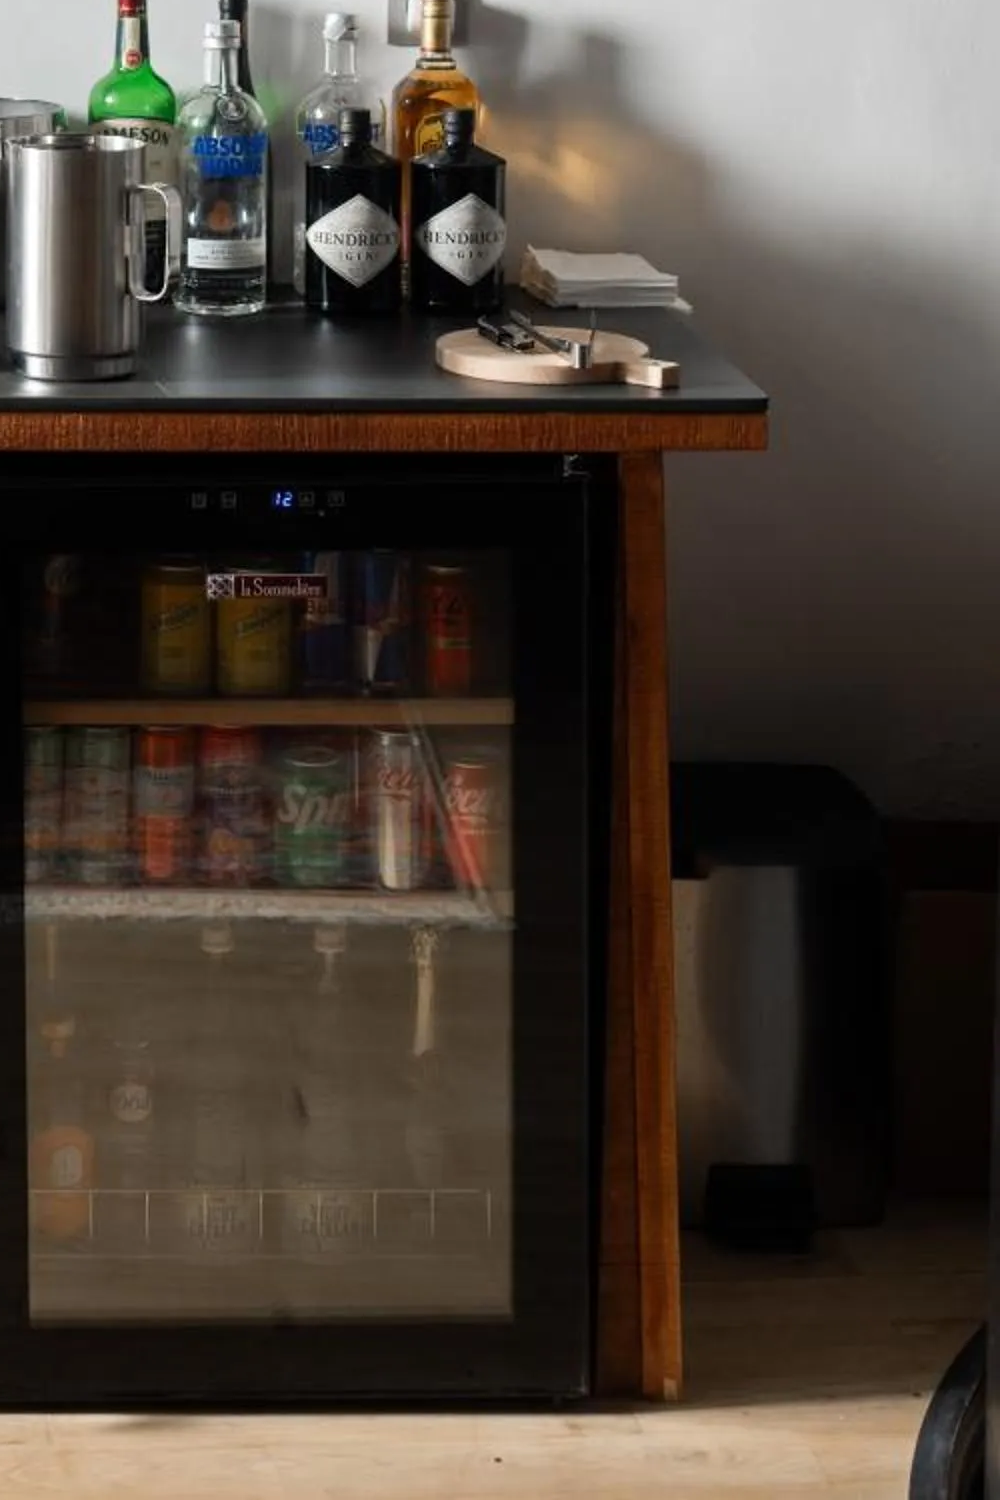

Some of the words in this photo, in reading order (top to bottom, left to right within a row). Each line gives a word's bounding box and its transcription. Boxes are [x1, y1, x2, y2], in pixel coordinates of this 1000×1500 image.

[304, 123, 380, 142] ABST
[344, 252, 374, 262] GIN
[456, 251, 486, 260] GIN
[276, 492, 293, 507] 12
